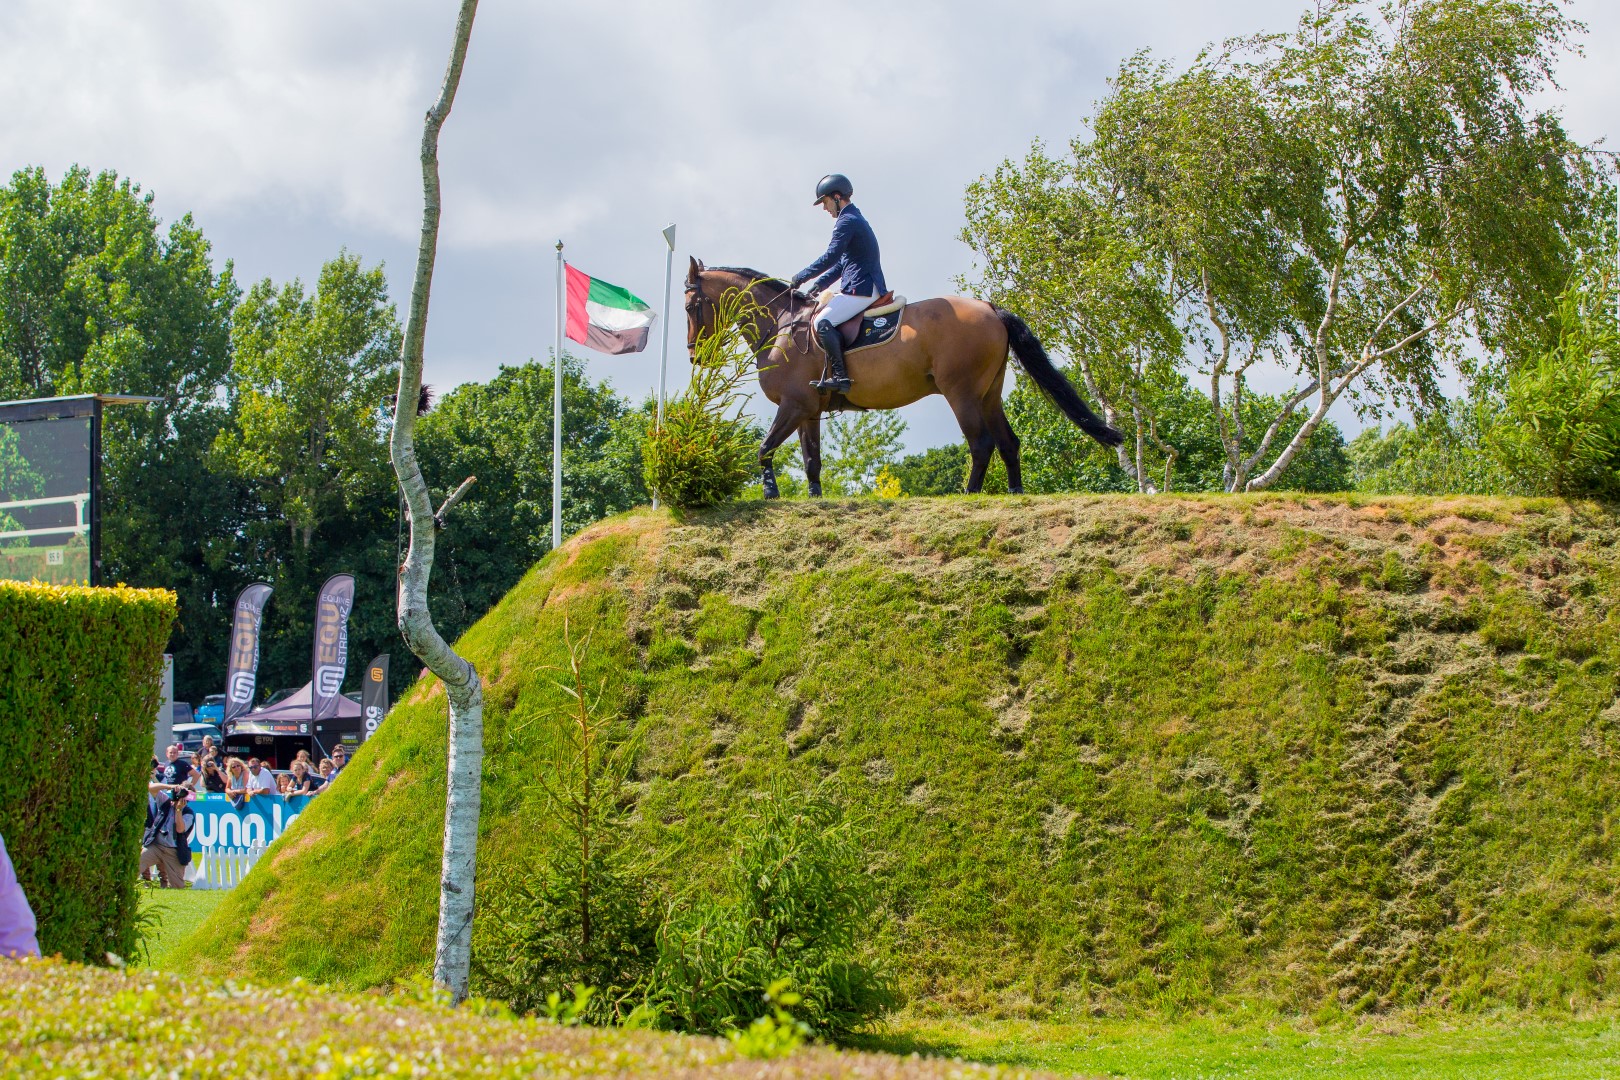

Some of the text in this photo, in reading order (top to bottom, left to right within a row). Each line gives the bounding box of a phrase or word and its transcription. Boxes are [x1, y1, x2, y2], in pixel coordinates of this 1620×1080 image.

[233, 610, 255, 669] EQU
[319, 603, 340, 663] EQU
[338, 606, 349, 665] STREAMZ
[187, 813, 265, 847] unn
